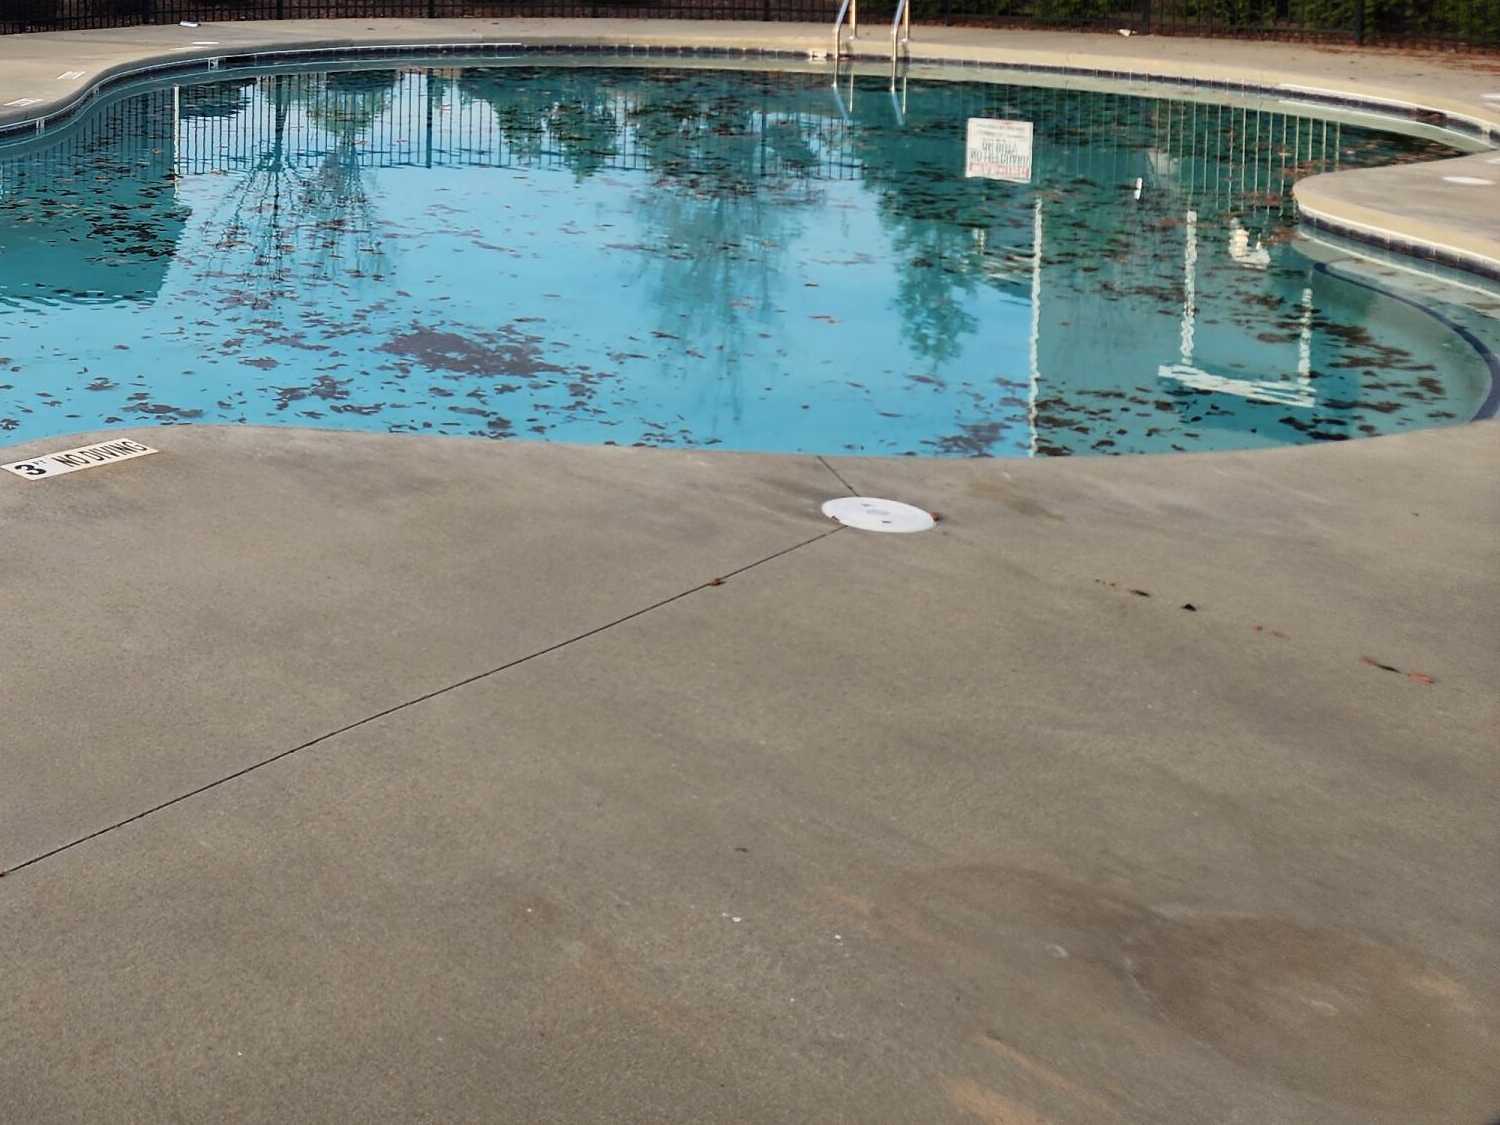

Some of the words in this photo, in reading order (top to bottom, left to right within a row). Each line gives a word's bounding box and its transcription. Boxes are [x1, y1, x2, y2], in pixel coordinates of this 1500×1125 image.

[14, 464, 47, 476] 3
[52, 454, 90, 467] NO
[80, 441, 148, 462] DIVING
